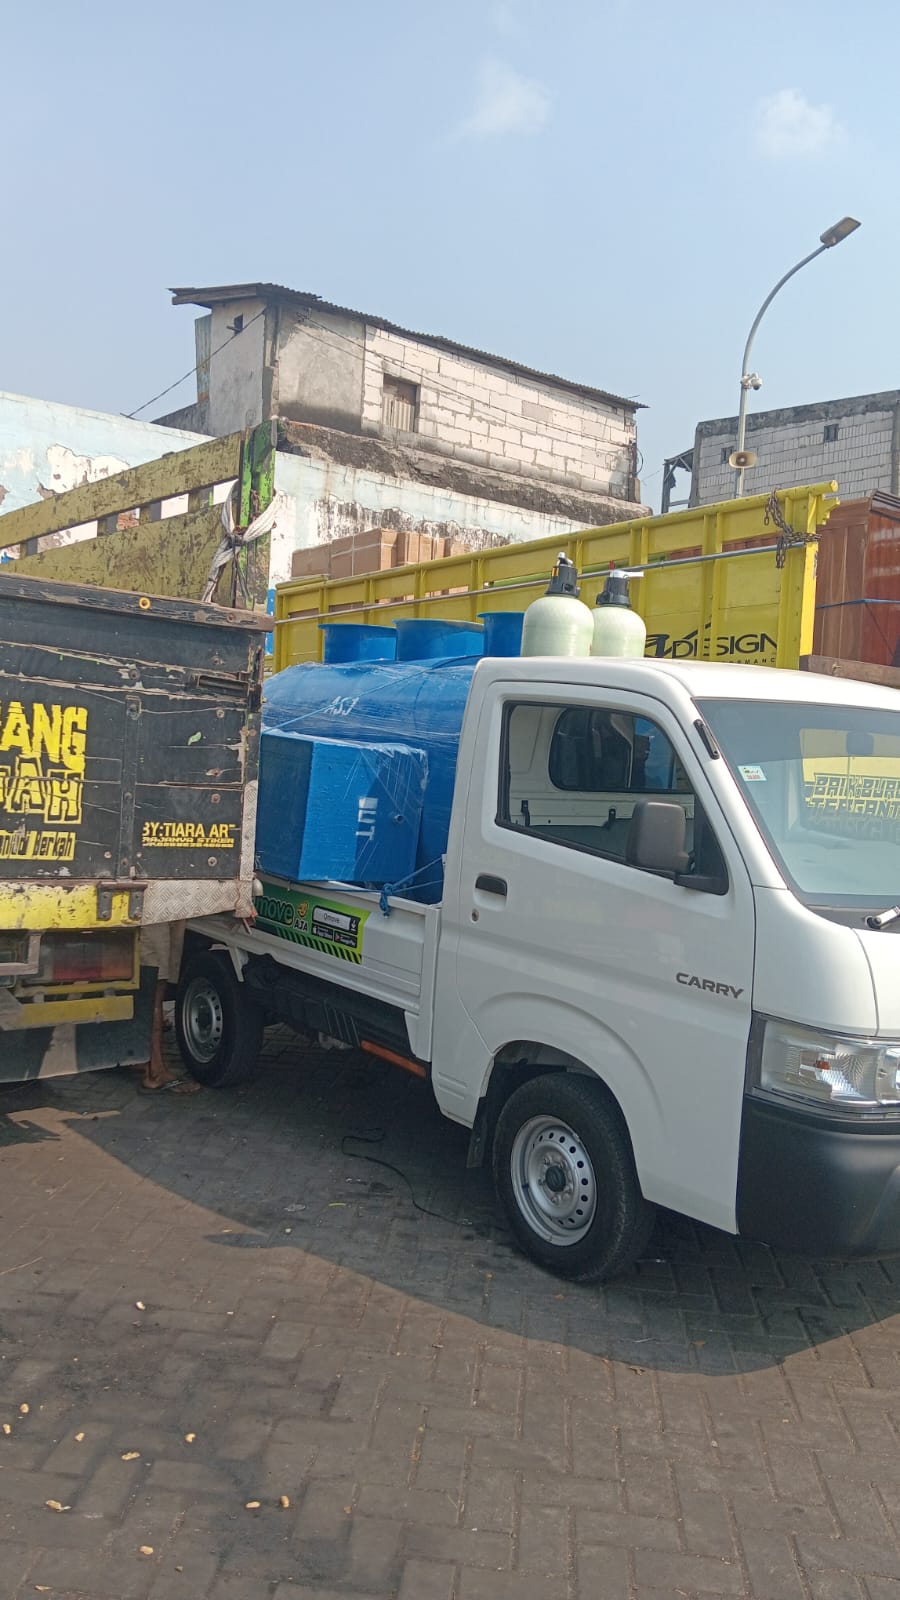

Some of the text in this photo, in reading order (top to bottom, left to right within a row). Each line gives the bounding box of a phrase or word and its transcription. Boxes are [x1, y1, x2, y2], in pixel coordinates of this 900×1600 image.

[0, 701, 88, 771] ANG
[861, 778, 900, 801] BUR
[675, 972, 744, 999] CARRY
